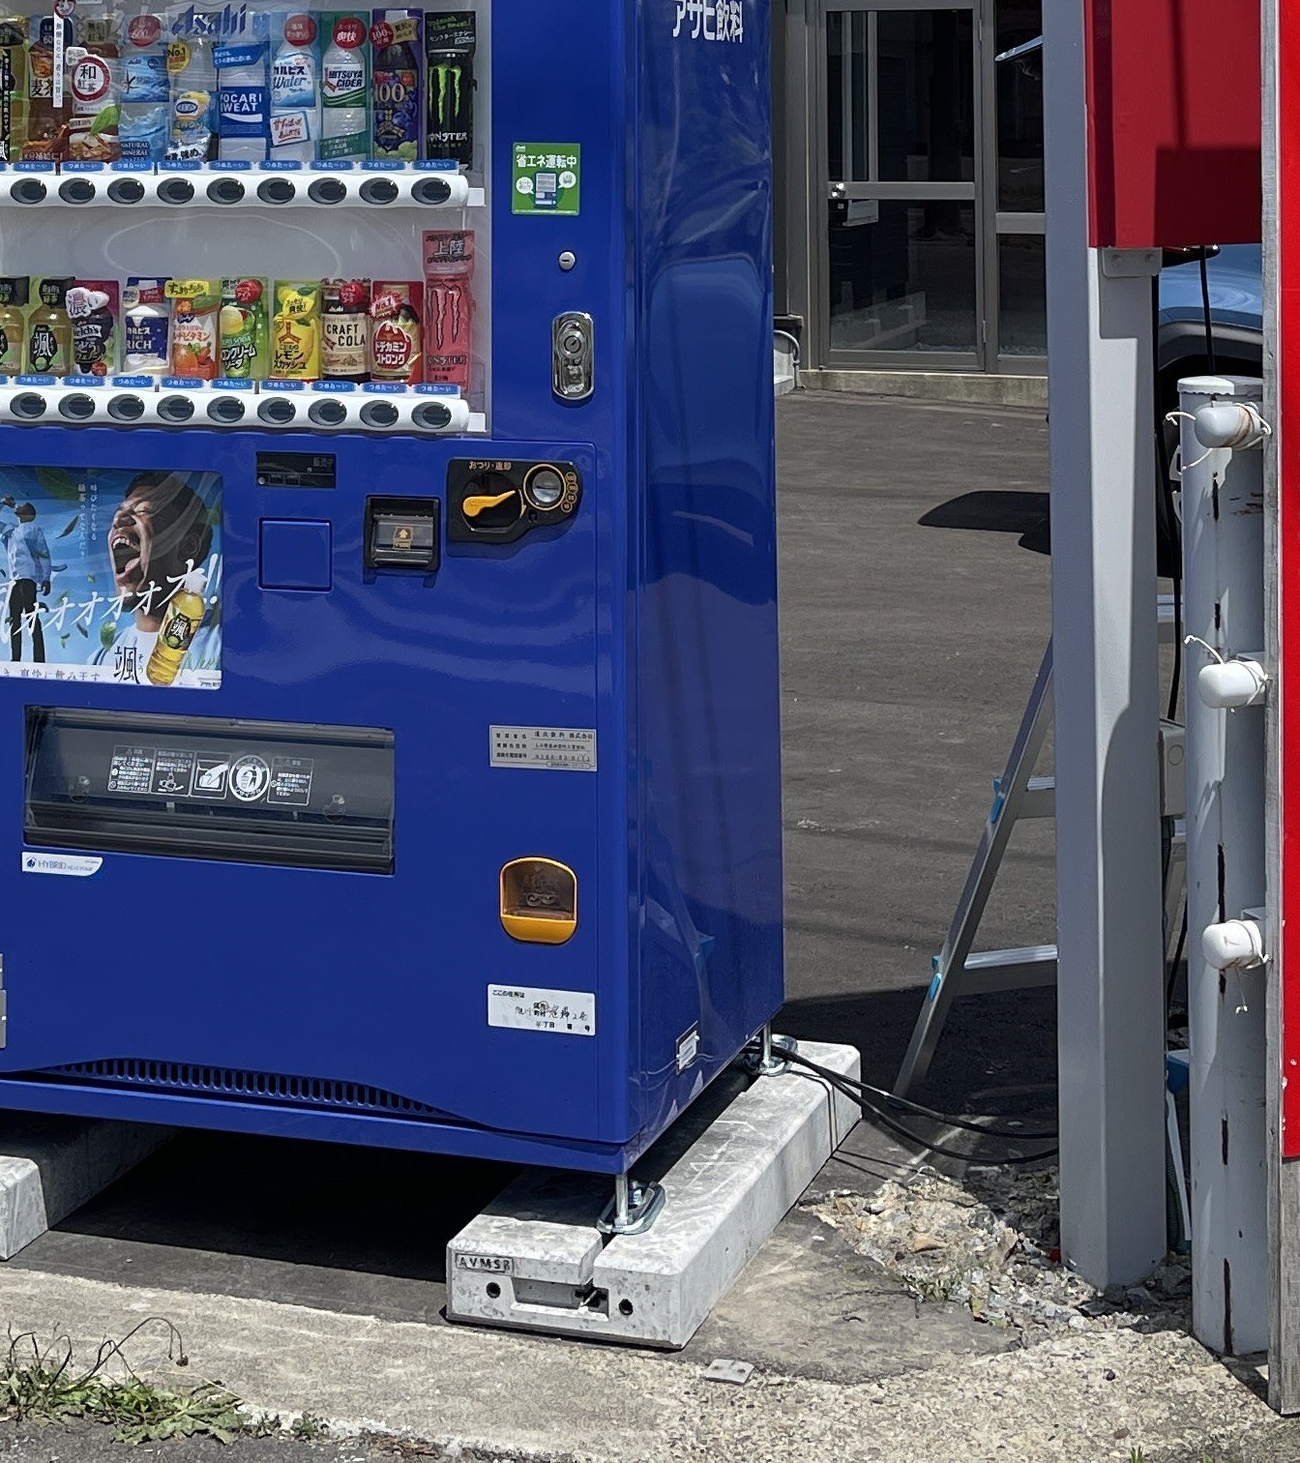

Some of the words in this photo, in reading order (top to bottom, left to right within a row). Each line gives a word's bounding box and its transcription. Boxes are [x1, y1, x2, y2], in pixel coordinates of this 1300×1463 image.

[328, 70, 363, 79] MITSUYA
[273, 76, 307, 90] Water
[336, 78, 363, 88] CIDER
[515, 154, 577, 169] 省エネ運転中
[434, 240, 464, 256] 上陸
[326, 323, 359, 334] CRAFT
[338, 335, 366, 346] COLA
[375, 341, 406, 353] ドデカミン
[275, 350, 303, 360] レモン
[375, 353, 405, 365] ストロング
[273, 361, 307, 370] スカッシュ
